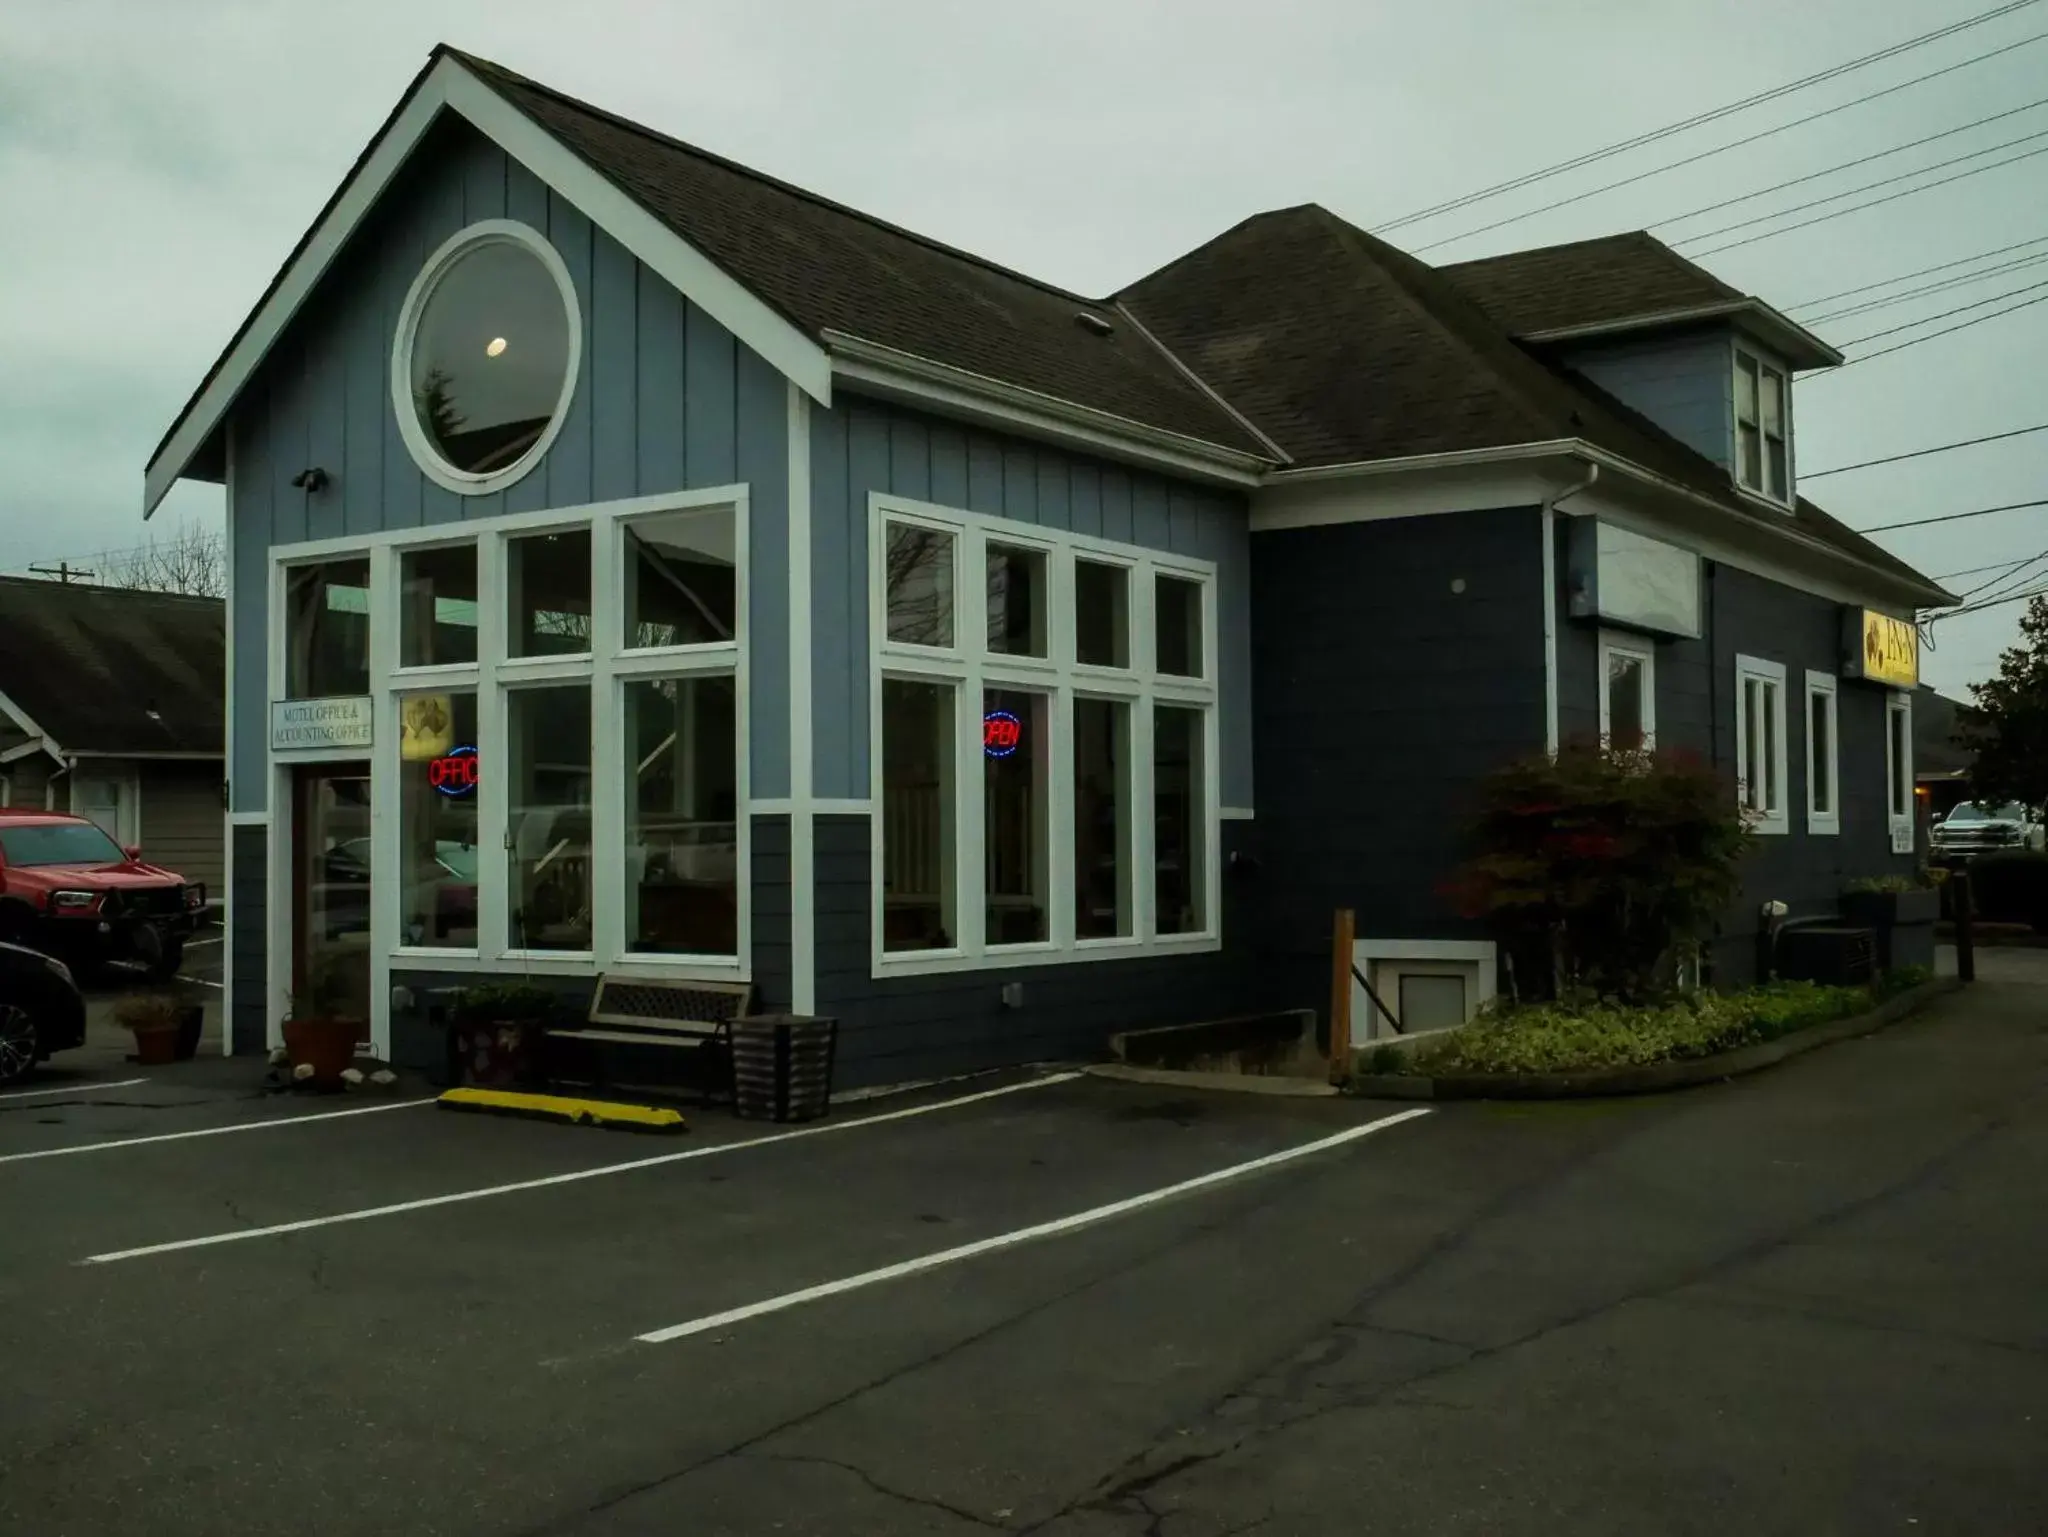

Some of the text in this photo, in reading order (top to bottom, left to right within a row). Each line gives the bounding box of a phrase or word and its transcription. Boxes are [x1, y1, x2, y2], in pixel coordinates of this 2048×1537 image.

[1887, 619, 1915, 665] INN
[284, 707, 314, 721] MOTEL
[316, 705, 348, 720] OFFICE
[275, 724, 369, 742] ACCOUNTING OFFICE
[429, 756, 478, 785] OFFIC
